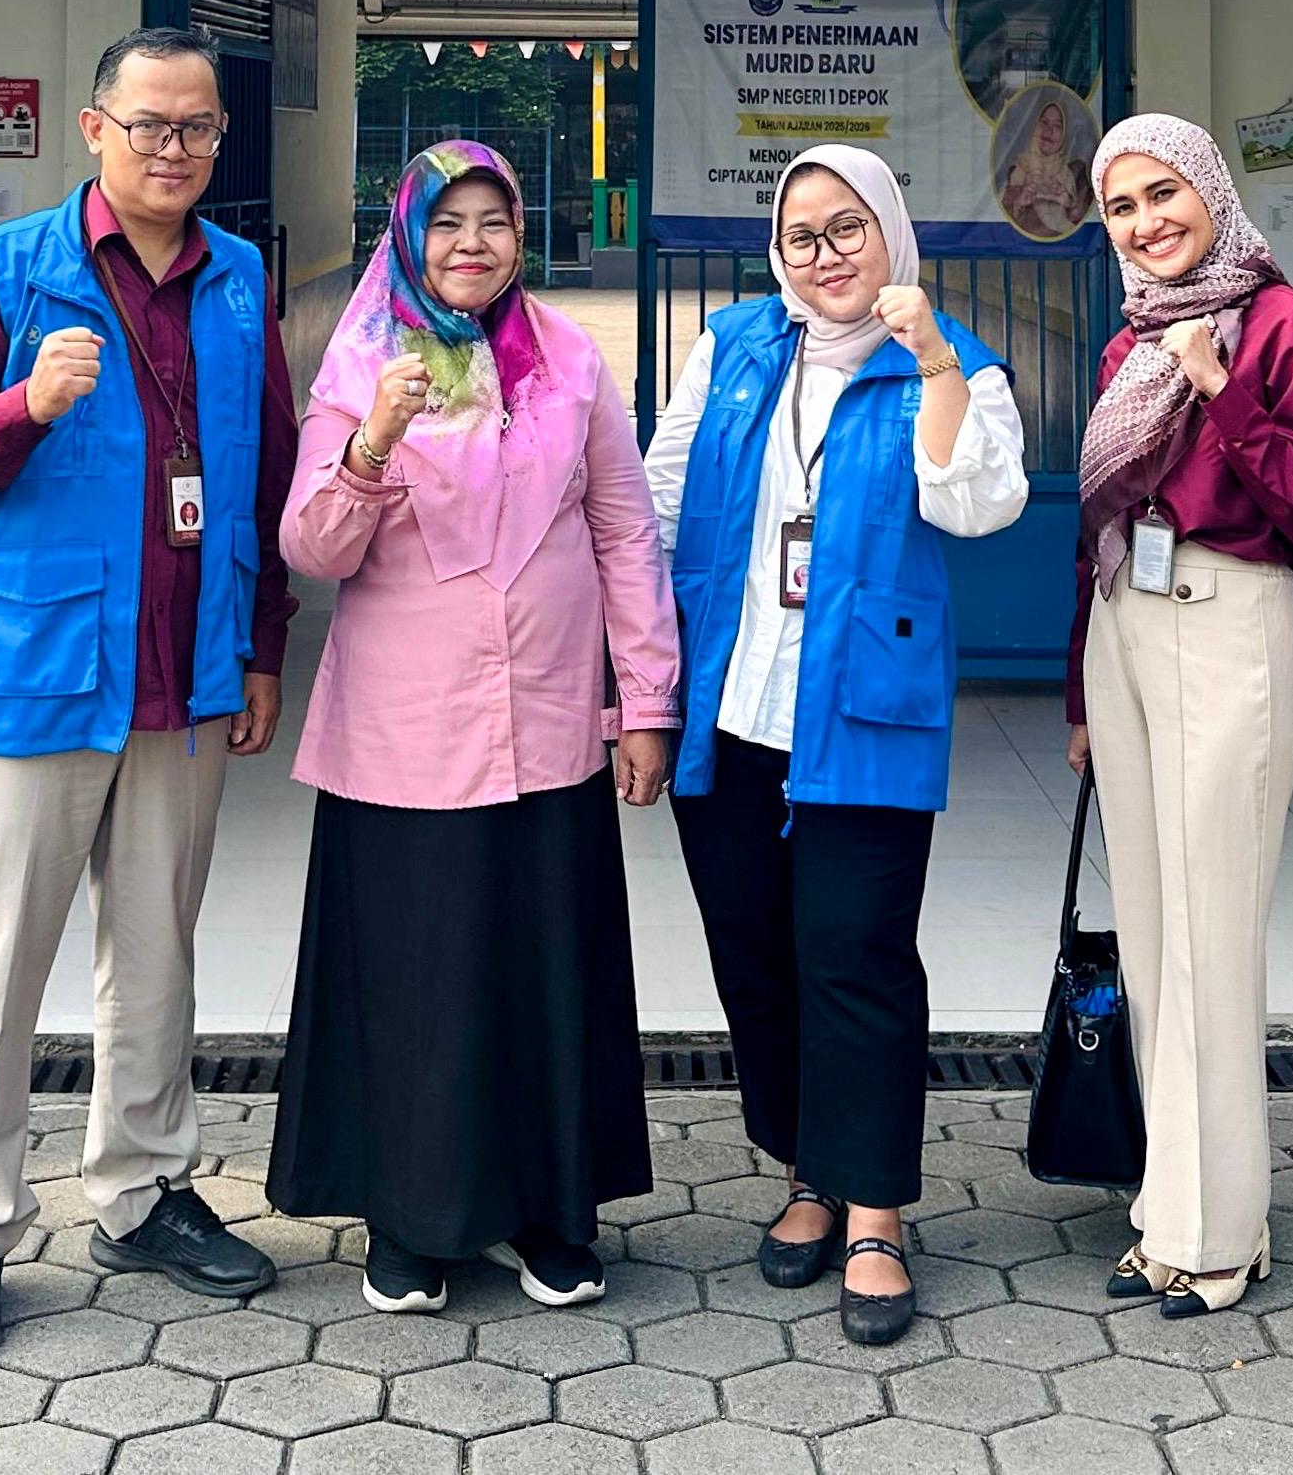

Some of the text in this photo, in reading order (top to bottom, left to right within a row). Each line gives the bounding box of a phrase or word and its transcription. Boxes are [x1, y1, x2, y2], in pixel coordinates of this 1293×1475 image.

[704, 23, 918, 46] SISTEM PENERIMAAN
[745, 53, 875, 74] MURID BARU
[737, 88, 889, 106] SMP NEGERI 1 DEPOK
[756, 119, 785, 130] TAHUN
[708, 168, 774, 185] CIPTAKAN
